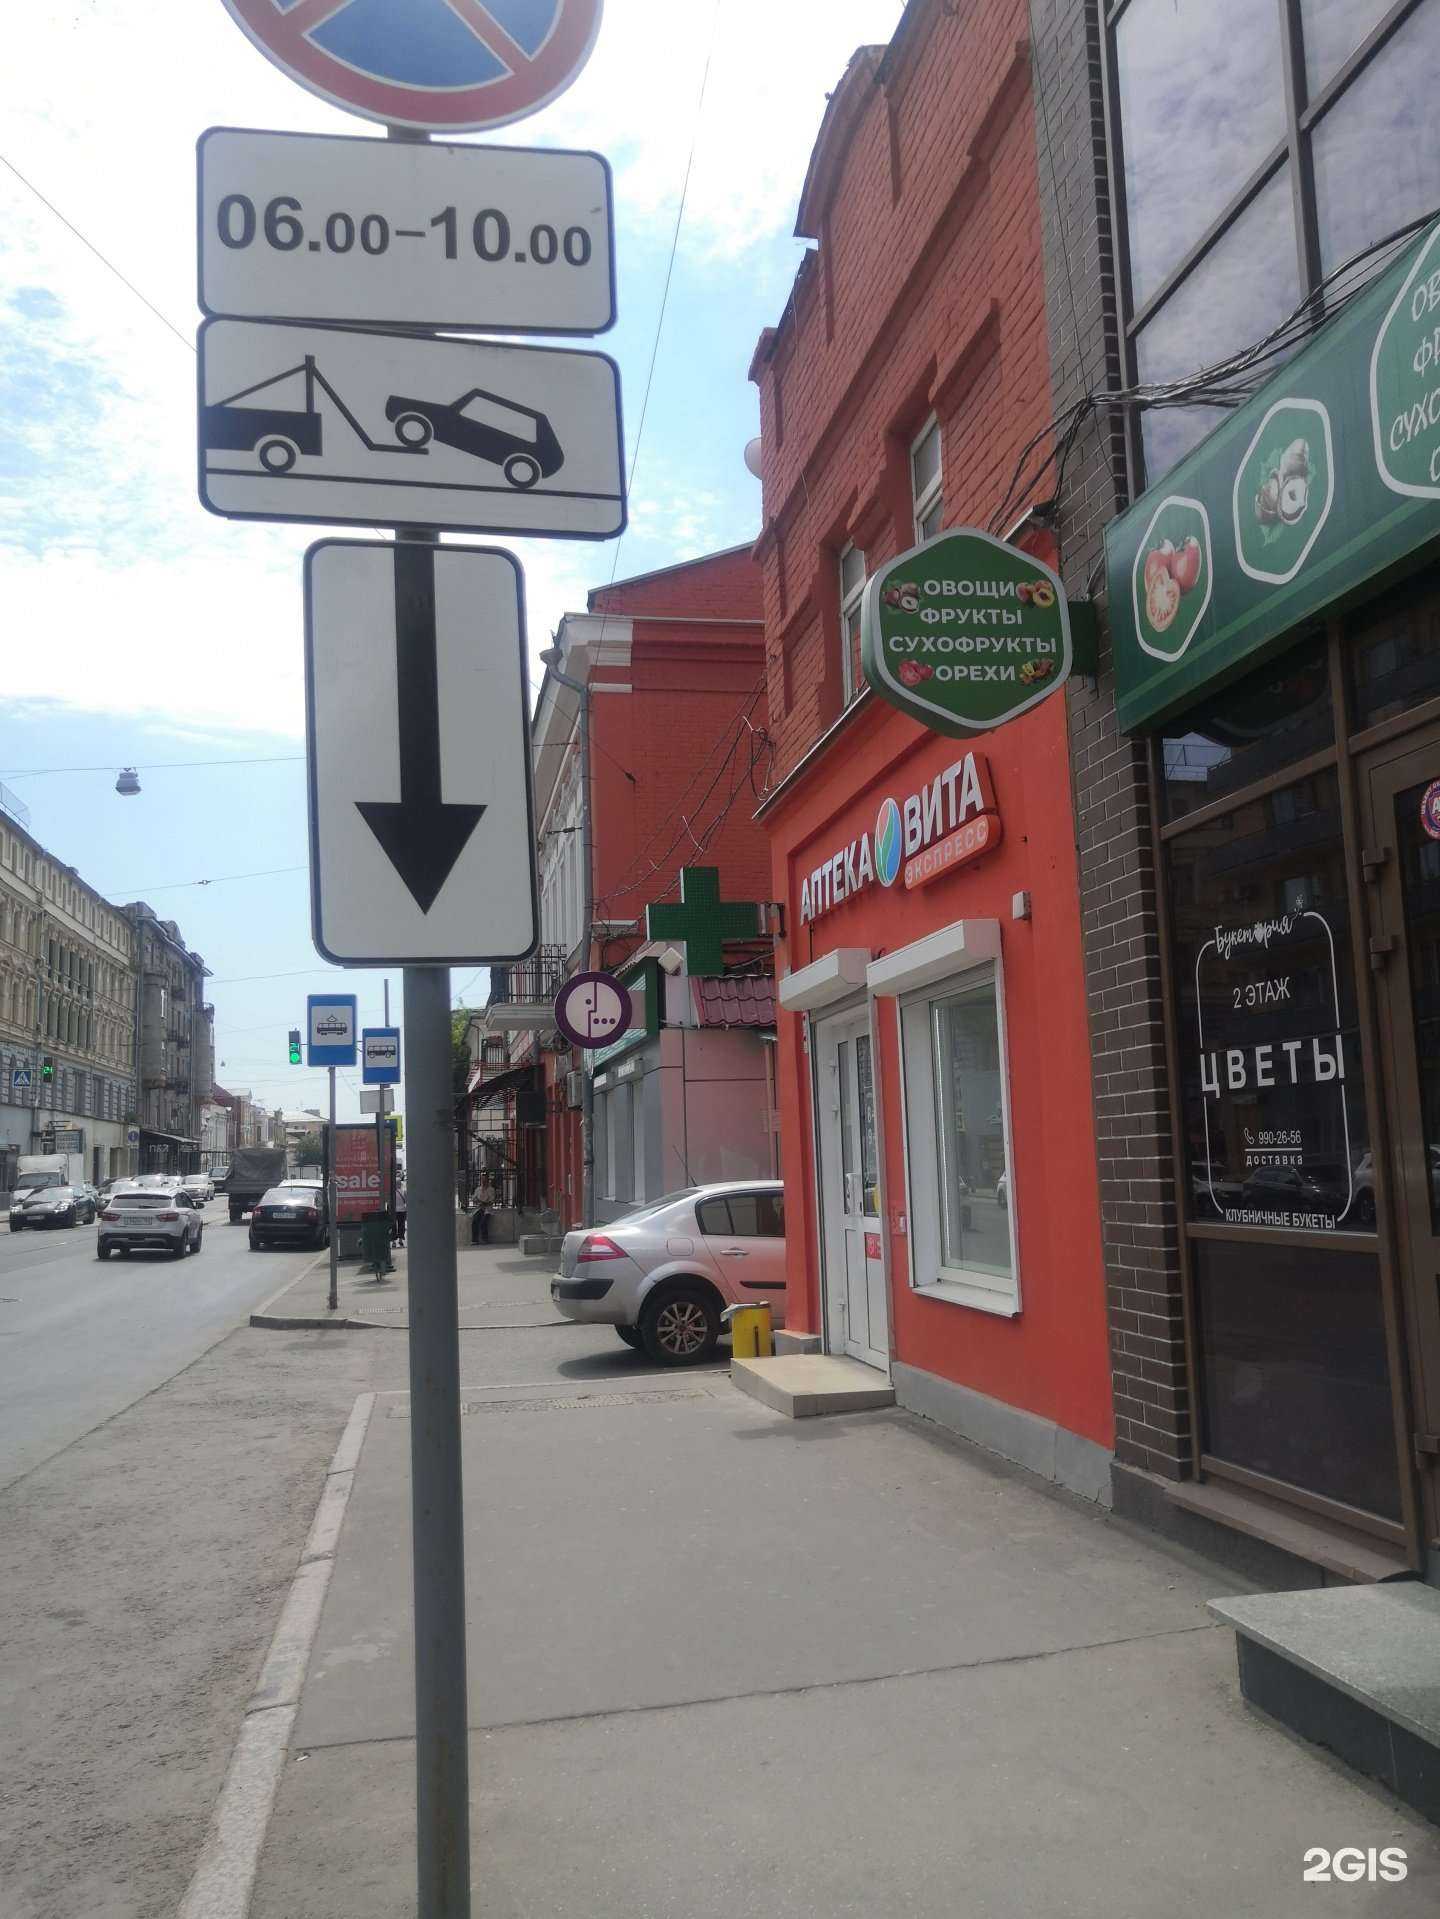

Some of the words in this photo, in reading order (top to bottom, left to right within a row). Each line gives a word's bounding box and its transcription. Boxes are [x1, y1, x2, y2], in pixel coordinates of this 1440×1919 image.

[923, 579, 1015, 598] ОВОЩИ
[919, 608, 1022, 625] ФРУКТЫ
[889, 636, 1056, 653] СУХОФРУКТЫ
[935, 665, 1016, 681] ОРЕХИ
[800, 832, 874, 926] АПТЕКА
[903, 751, 984, 857] ВИТА
[1233, 987, 1242, 1009] 2
[1245, 976, 1291, 1006] ЭТАЖ
[1200, 1034, 1345, 1099] ЦВЕТЫ
[1258, 1130, 1302, 1145] 990-26-56
[1246, 1155, 1303, 1167] доставка
[335, 1169, 380, 1189] sale
[1225, 1208, 1290, 1226] КЛУБНИЧНЫЕ
[1292, 1212, 1336, 1229] БУКЕТЫ
